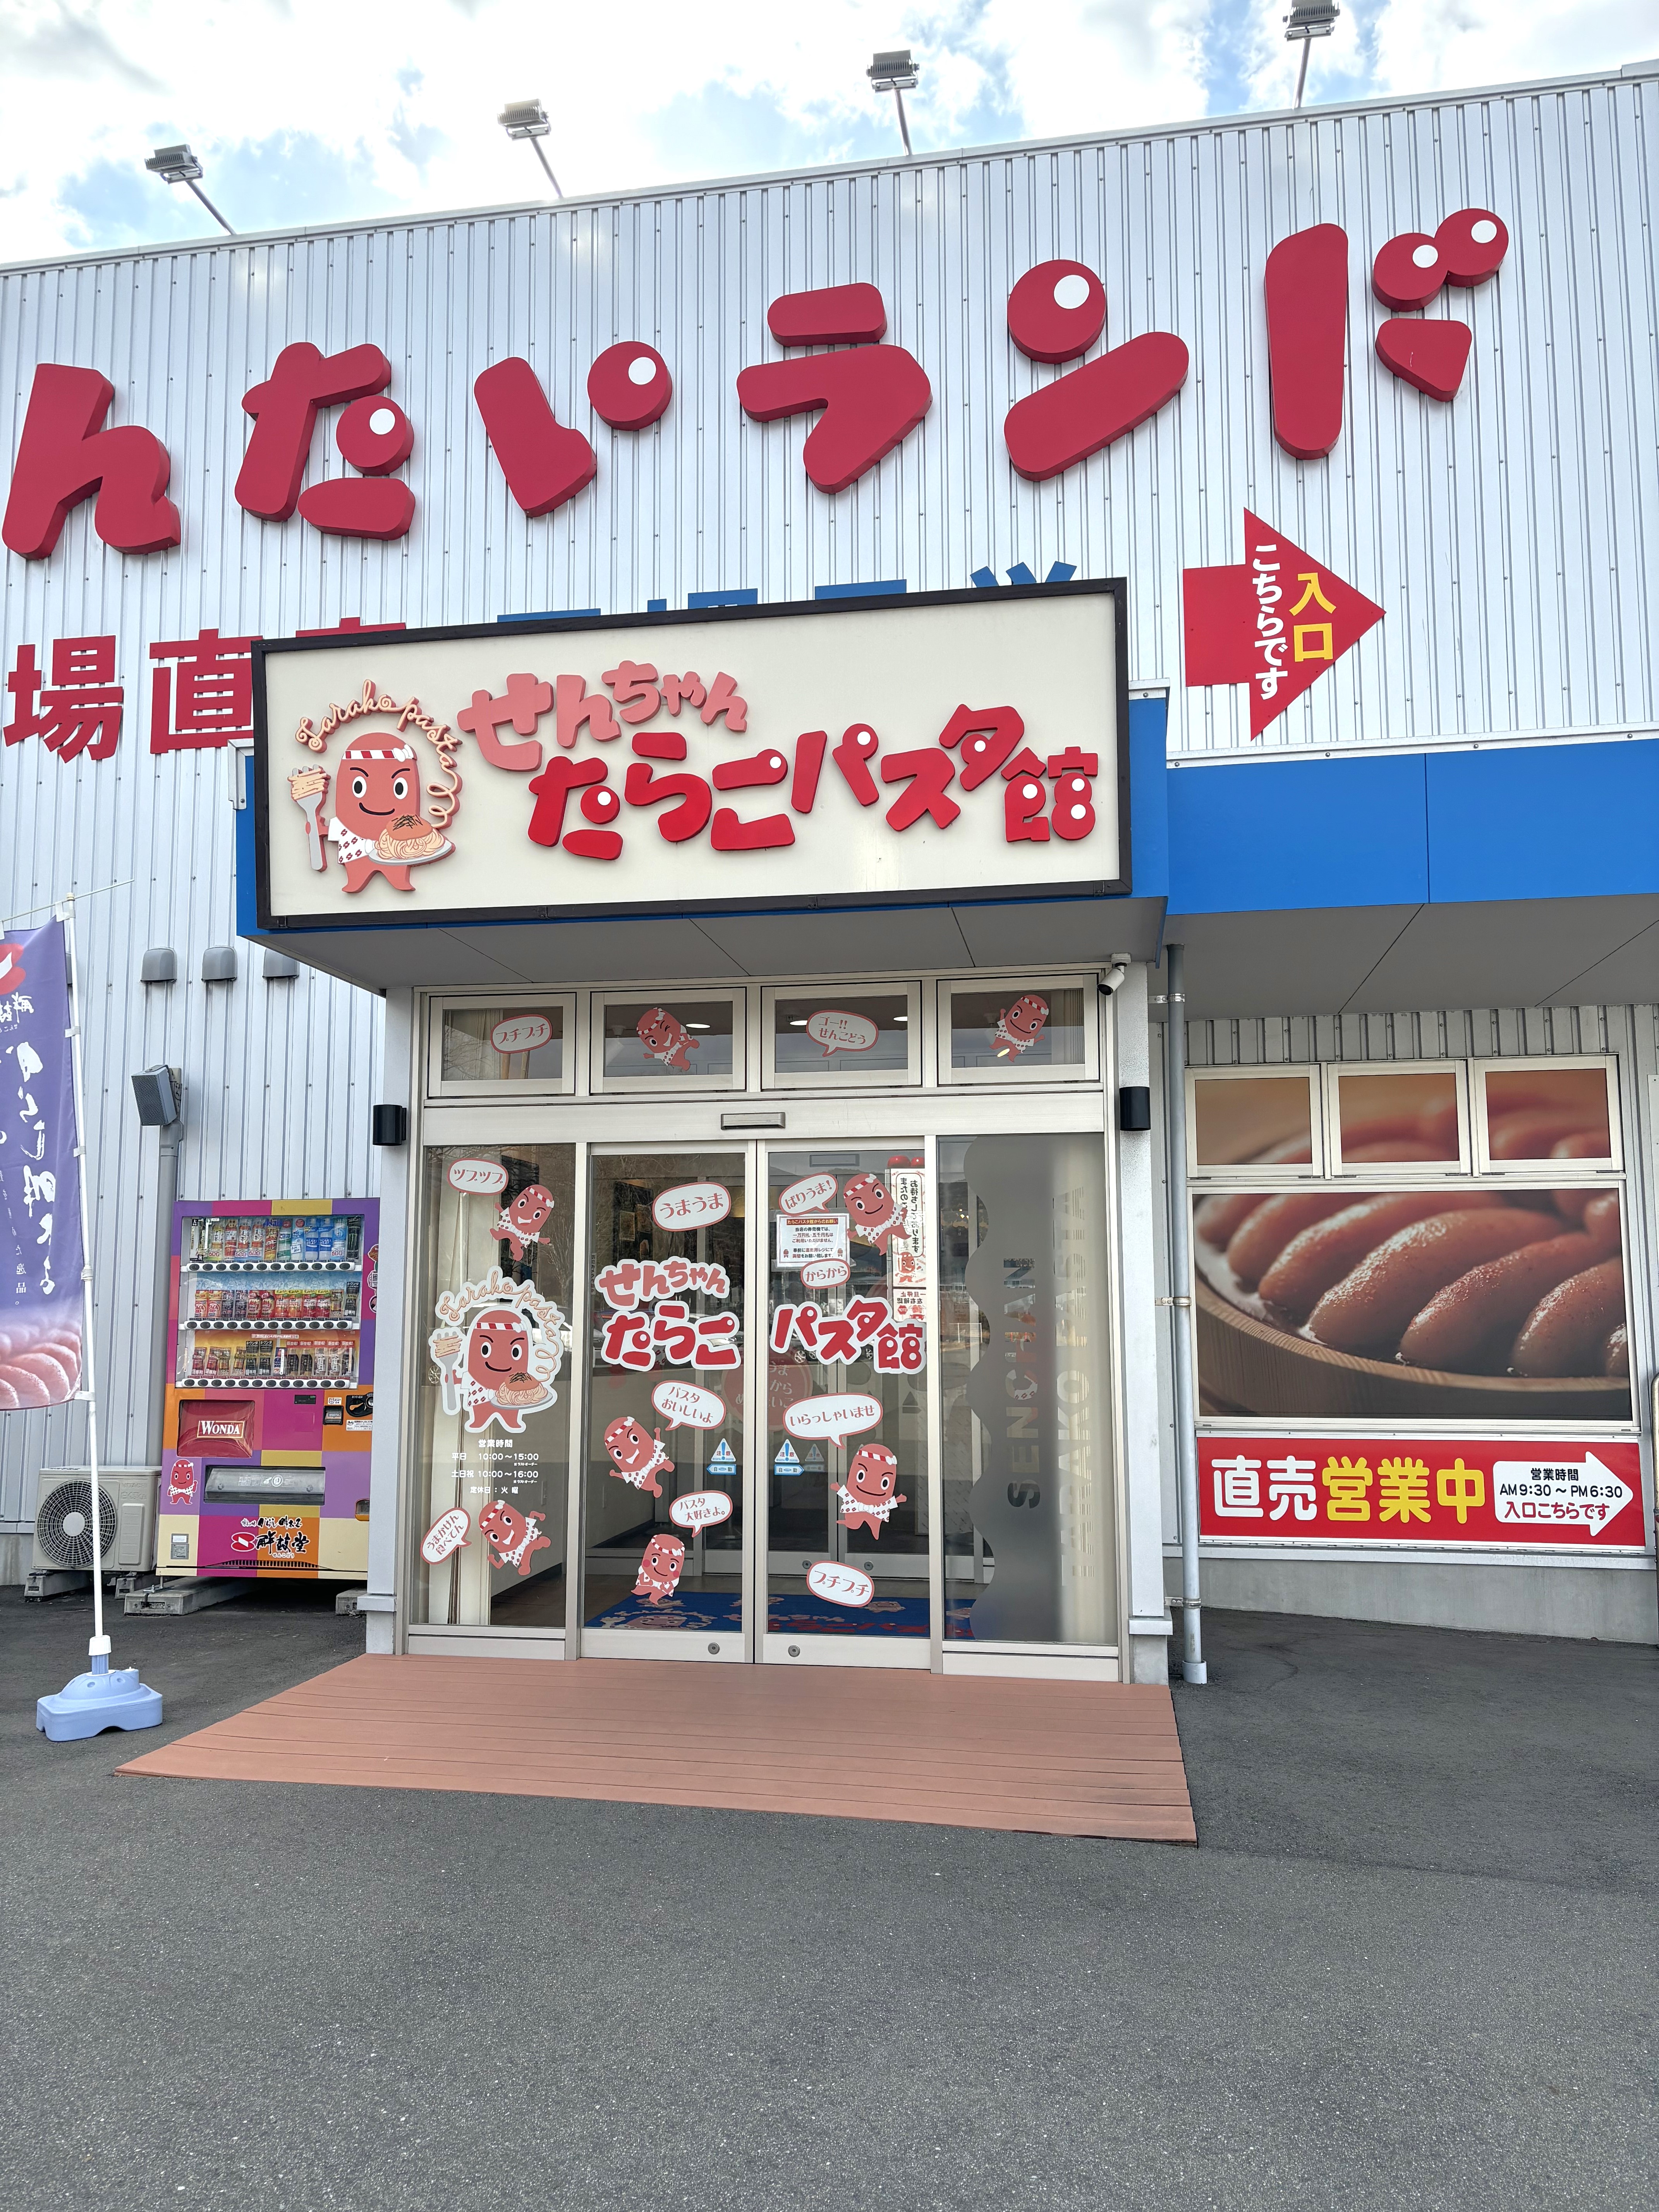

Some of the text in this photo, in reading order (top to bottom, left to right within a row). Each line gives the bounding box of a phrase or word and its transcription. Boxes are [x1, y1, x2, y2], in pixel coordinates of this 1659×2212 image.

[1250, 544, 1289, 700] こちらです
[1290, 573, 1337, 662] 入口
[457, 659, 748, 771] せんちゃん
[528, 704, 1098, 860] たらこパスタ館
[496, 1023, 548, 1044] プチプチ
[819, 1027, 866, 1045] せんこどう
[454, 1169, 503, 1184] ツブツブ
[659, 1193, 723, 1219] うまうま
[599, 1261, 725, 1307] せんちゃん
[805, 1266, 847, 1281] からから
[606, 1305, 737, 1367] たらこ
[775, 1300, 922, 1369] パスタ館
[668, 1386, 700, 1403] パスタ
[1003, 1258, 1041, 1509] SENCHAN
[661, 1398, 713, 1424] おいしいよ
[790, 1405, 875, 1427] いらっしゃいませ
[201, 1420, 240, 1434] WONDA
[478, 1439, 513, 1448] 営業時間
[452, 1453, 467, 1461] 平日
[1056, 1369, 1095, 1586] TARAKO
[1530, 1468, 1579, 1481] 営業時間
[1211, 1455, 1486, 1524] 直売営業中
[1499, 1484, 1551, 1496] AM9:30
[1571, 1485, 1623, 1498] PM6:30
[680, 1498, 705, 1511] パスタ
[685, 1506, 725, 1522] 大好きよ。
[1504, 1501, 1610, 1520] 入口こちらです
[427, 1515, 459, 1550] うまかけん
[436, 1525, 464, 1555] 食べてん
[814, 1570, 869, 1597] プチプチ
